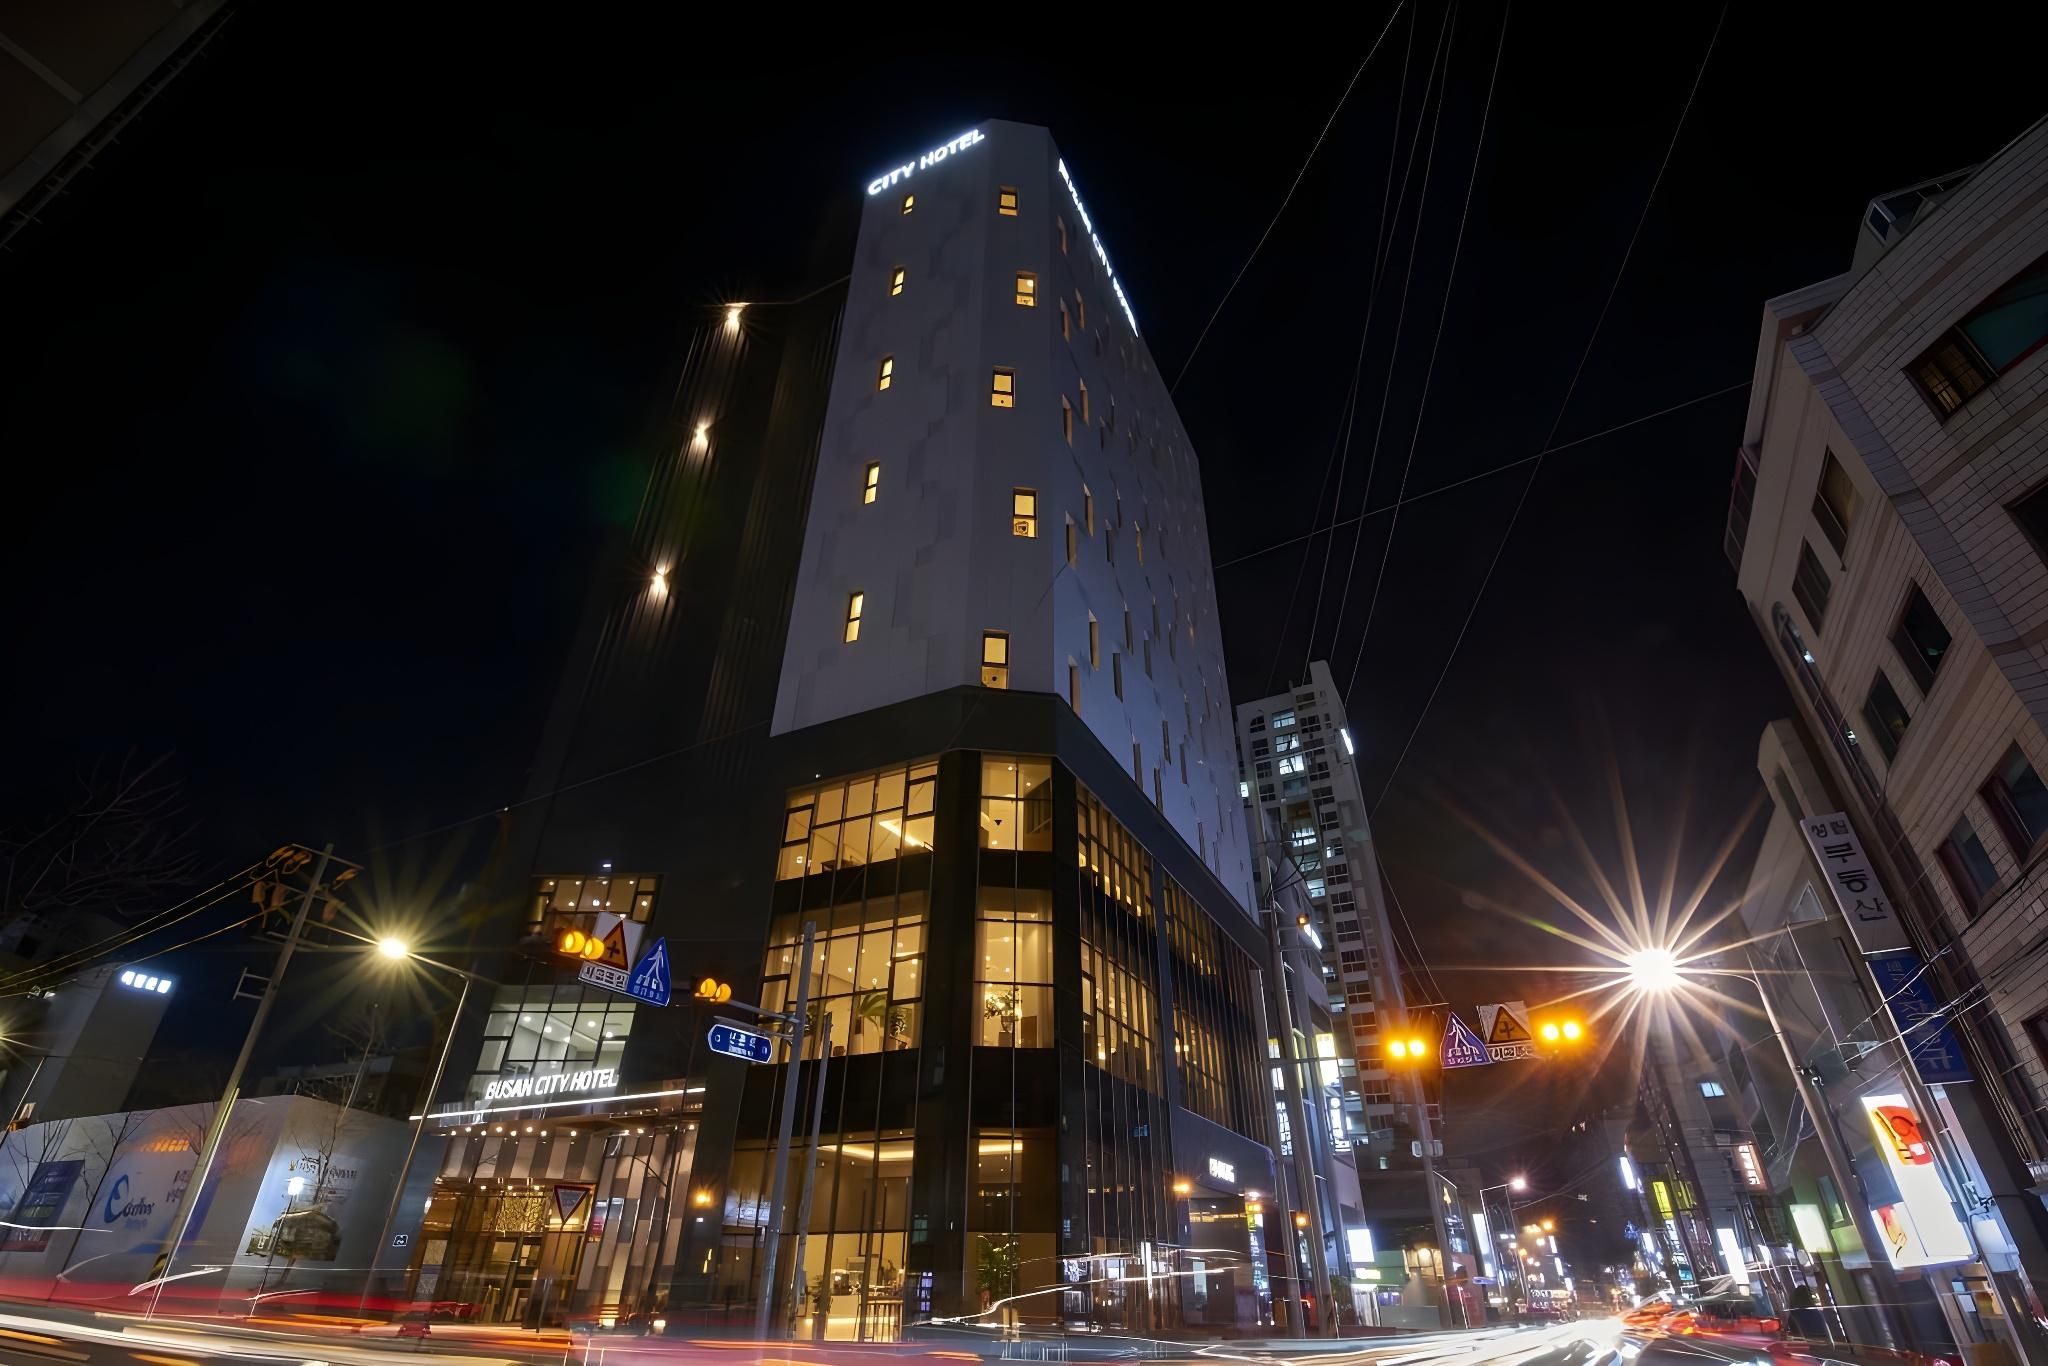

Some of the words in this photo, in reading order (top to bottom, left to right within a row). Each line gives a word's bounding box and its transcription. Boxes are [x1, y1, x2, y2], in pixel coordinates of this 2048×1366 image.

[868, 161, 916, 196] CITY
[920, 128, 985, 170] HOTEL
[484, 1077, 534, 1101] BUSAN
[534, 1073, 571, 1096] CITY
[570, 1068, 619, 1092] HOTEL
